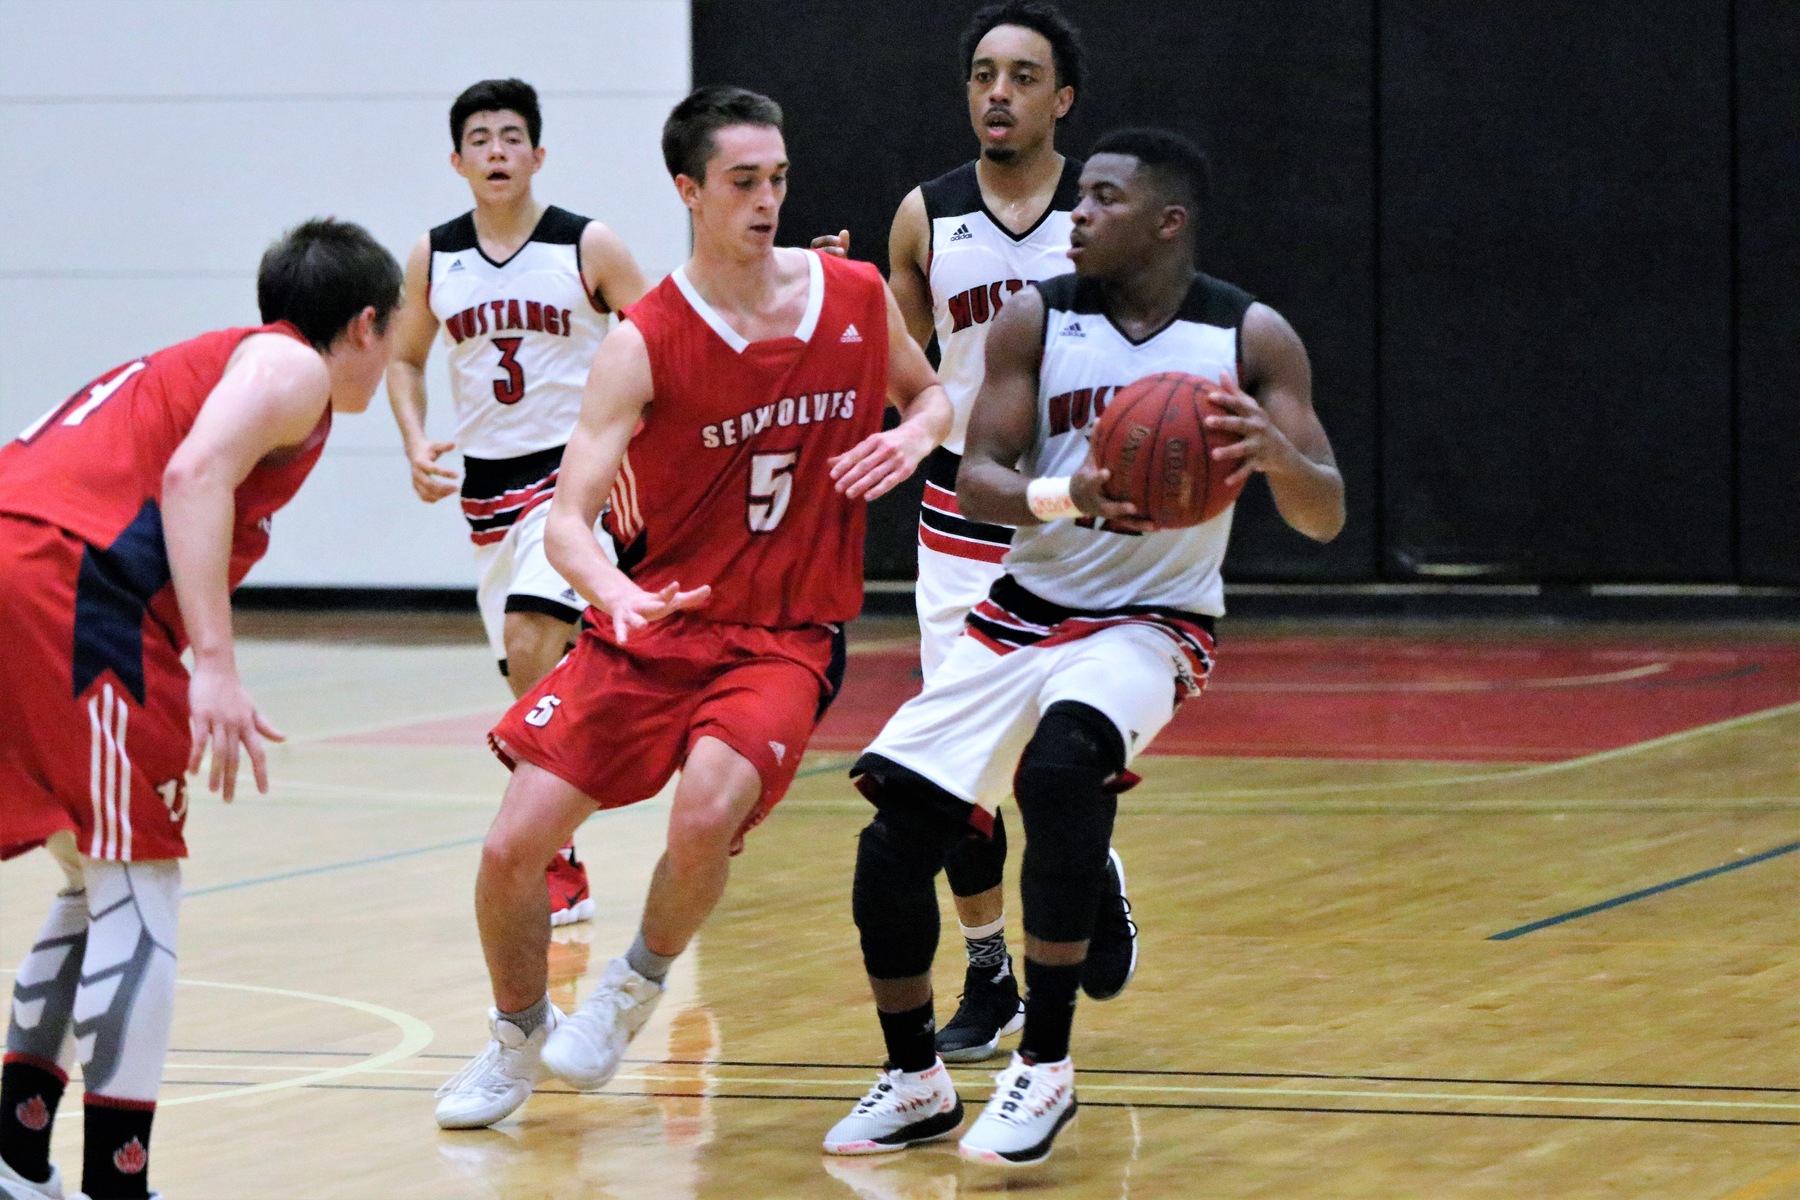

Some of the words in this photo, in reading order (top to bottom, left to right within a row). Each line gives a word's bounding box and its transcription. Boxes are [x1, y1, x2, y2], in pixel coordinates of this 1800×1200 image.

[950, 232, 973, 242] adidas
[445, 298, 572, 346] MUSTANGS
[490, 336, 525, 405] 3
[700, 387, 858, 450] SEAWOLVES
[745, 445, 803, 537] 5
[524, 693, 562, 729] 5
